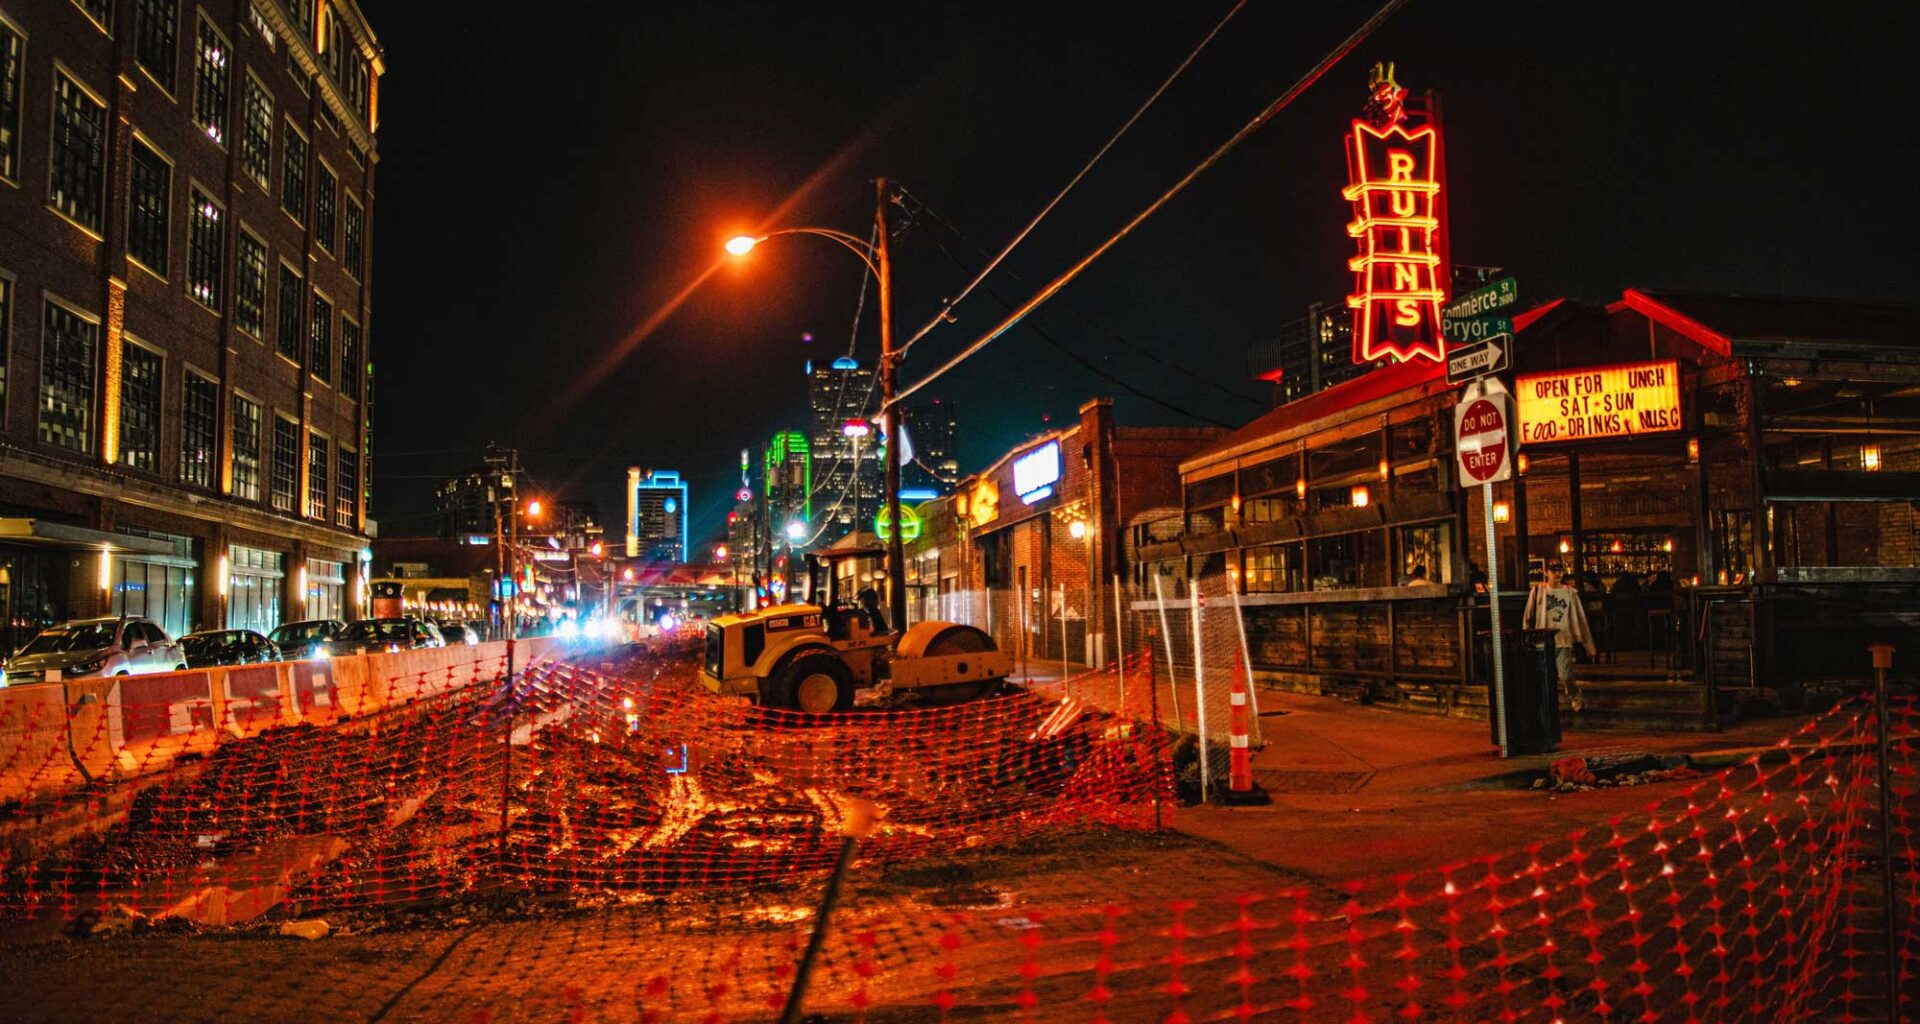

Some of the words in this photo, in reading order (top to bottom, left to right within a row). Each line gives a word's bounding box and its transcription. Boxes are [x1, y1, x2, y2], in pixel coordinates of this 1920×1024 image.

[1388, 153, 1421, 327] RUINS
[1501, 282, 1509, 293] St
[1443, 319, 1489, 341] Pryor
[1497, 320, 1506, 330] St
[1451, 358, 1468, 372] ONE
[1470, 351, 1490, 367] WAY
[1535, 379, 1569, 399] OPEN
[1574, 374, 1602, 395] FOR
[1628, 367, 1665, 389] UNCH
[1560, 395, 1589, 416] SAT
[1603, 392, 1634, 412] SUN
[1464, 417, 1475, 431] DO
[1480, 412, 1497, 427] NOT
[1522, 420, 1557, 441] FOOD
[1568, 414, 1621, 437] DRINKS
[1469, 452, 1497, 469] ENTER
[803, 614, 821, 627] CAT
